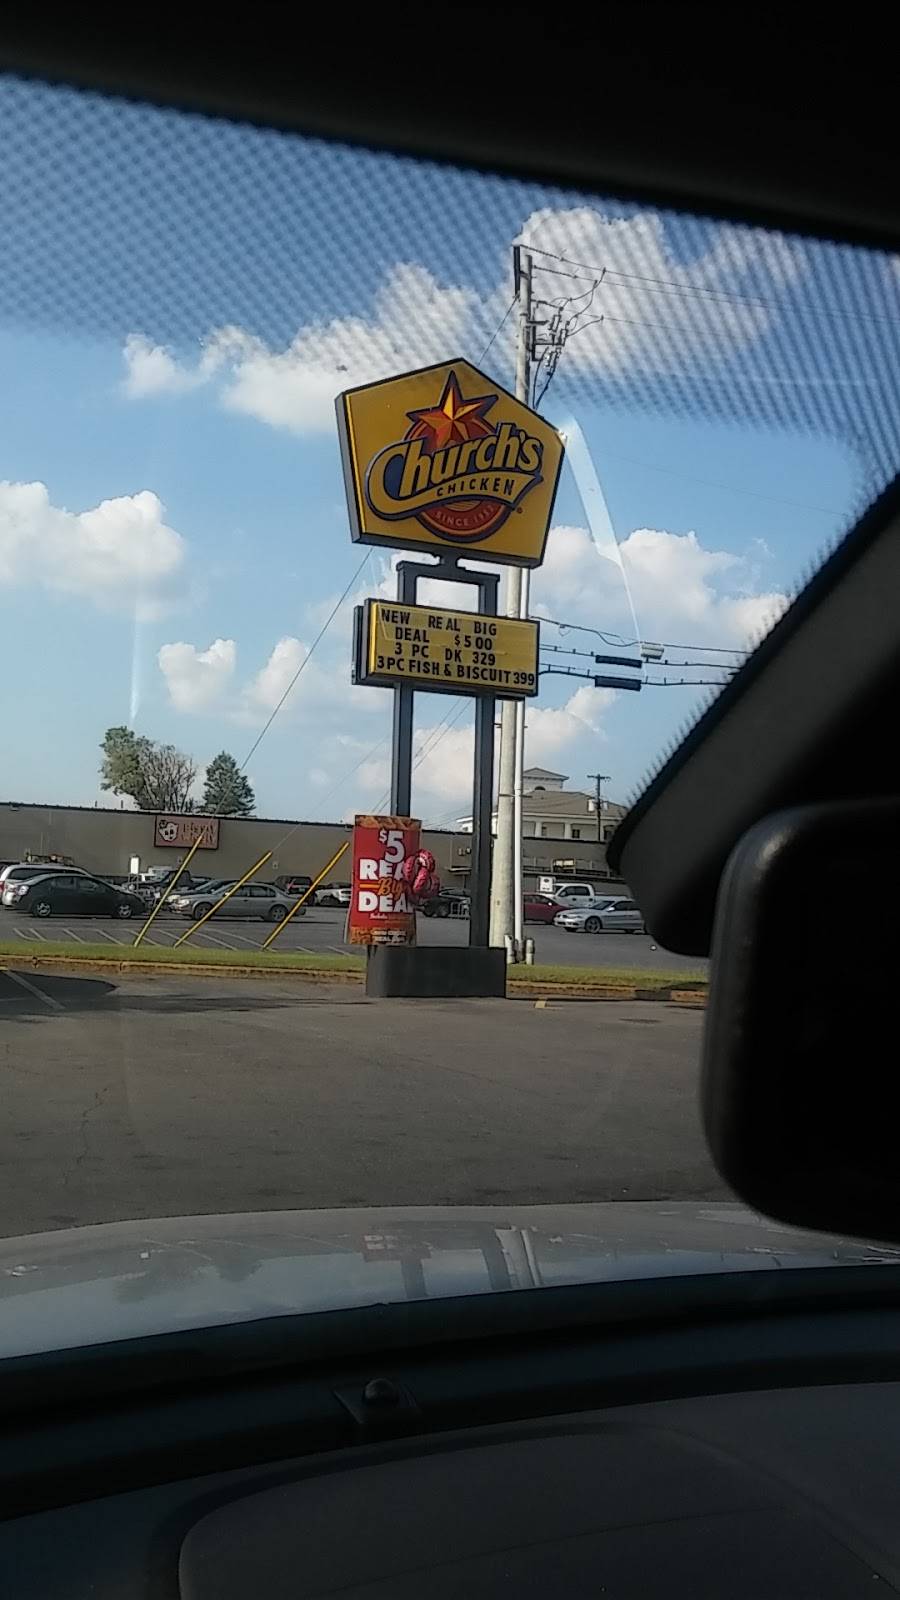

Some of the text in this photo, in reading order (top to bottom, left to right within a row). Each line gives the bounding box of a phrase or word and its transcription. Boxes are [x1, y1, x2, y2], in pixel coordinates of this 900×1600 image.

[366, 422, 544, 512] Church's
[436, 477, 515, 497] CHICKEN
[434, 510, 469, 527] SINCE
[381, 609, 497, 636] NEW REAL BIG
[395, 627, 430, 643] DEAL
[394, 642, 496, 666] 3 PC DK 329
[409, 659, 440, 676] FISH
[443, 663, 452, 677] &
[378, 828, 405, 864] $5
